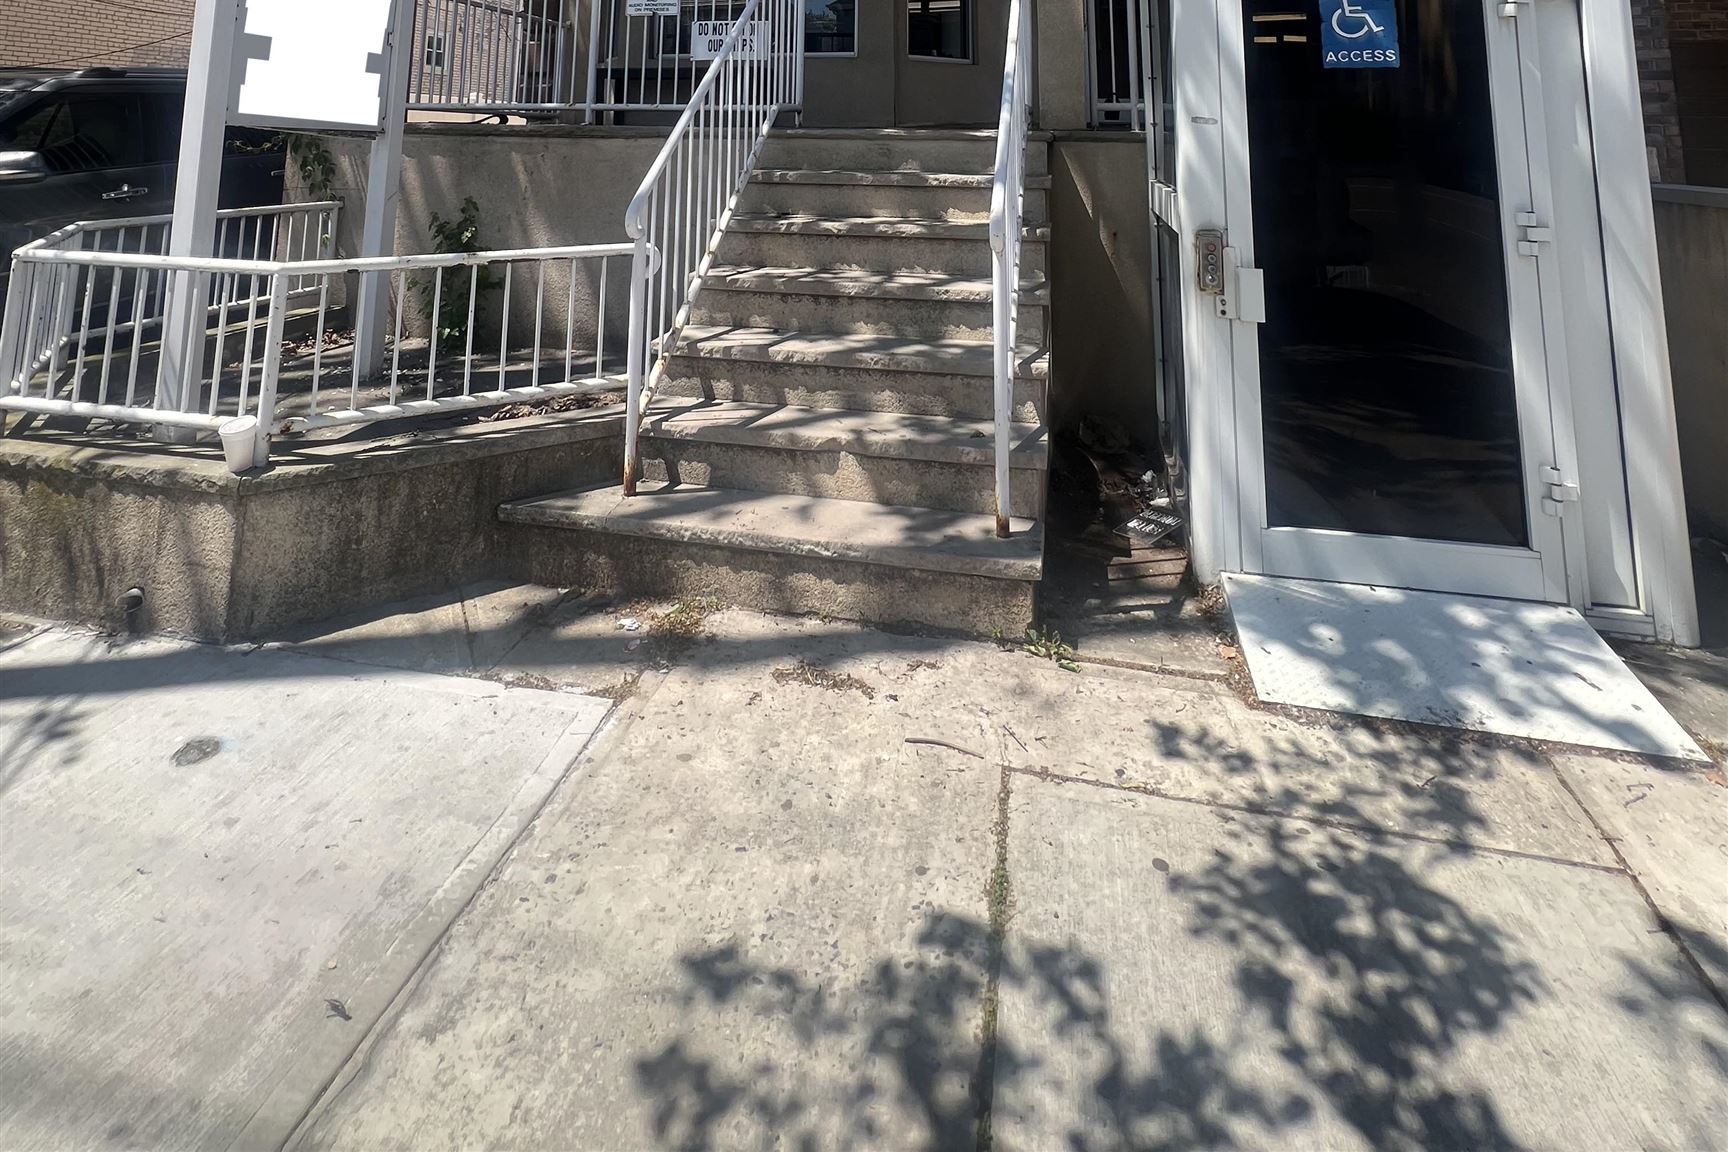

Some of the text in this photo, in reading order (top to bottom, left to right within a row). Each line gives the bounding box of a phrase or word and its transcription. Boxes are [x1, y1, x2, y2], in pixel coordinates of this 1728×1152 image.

[698, 22, 709, 36] DO
[712, 22, 730, 36] NOT
[707, 39, 724, 52] OUR
[1326, 49, 1397, 62] ACCESS
